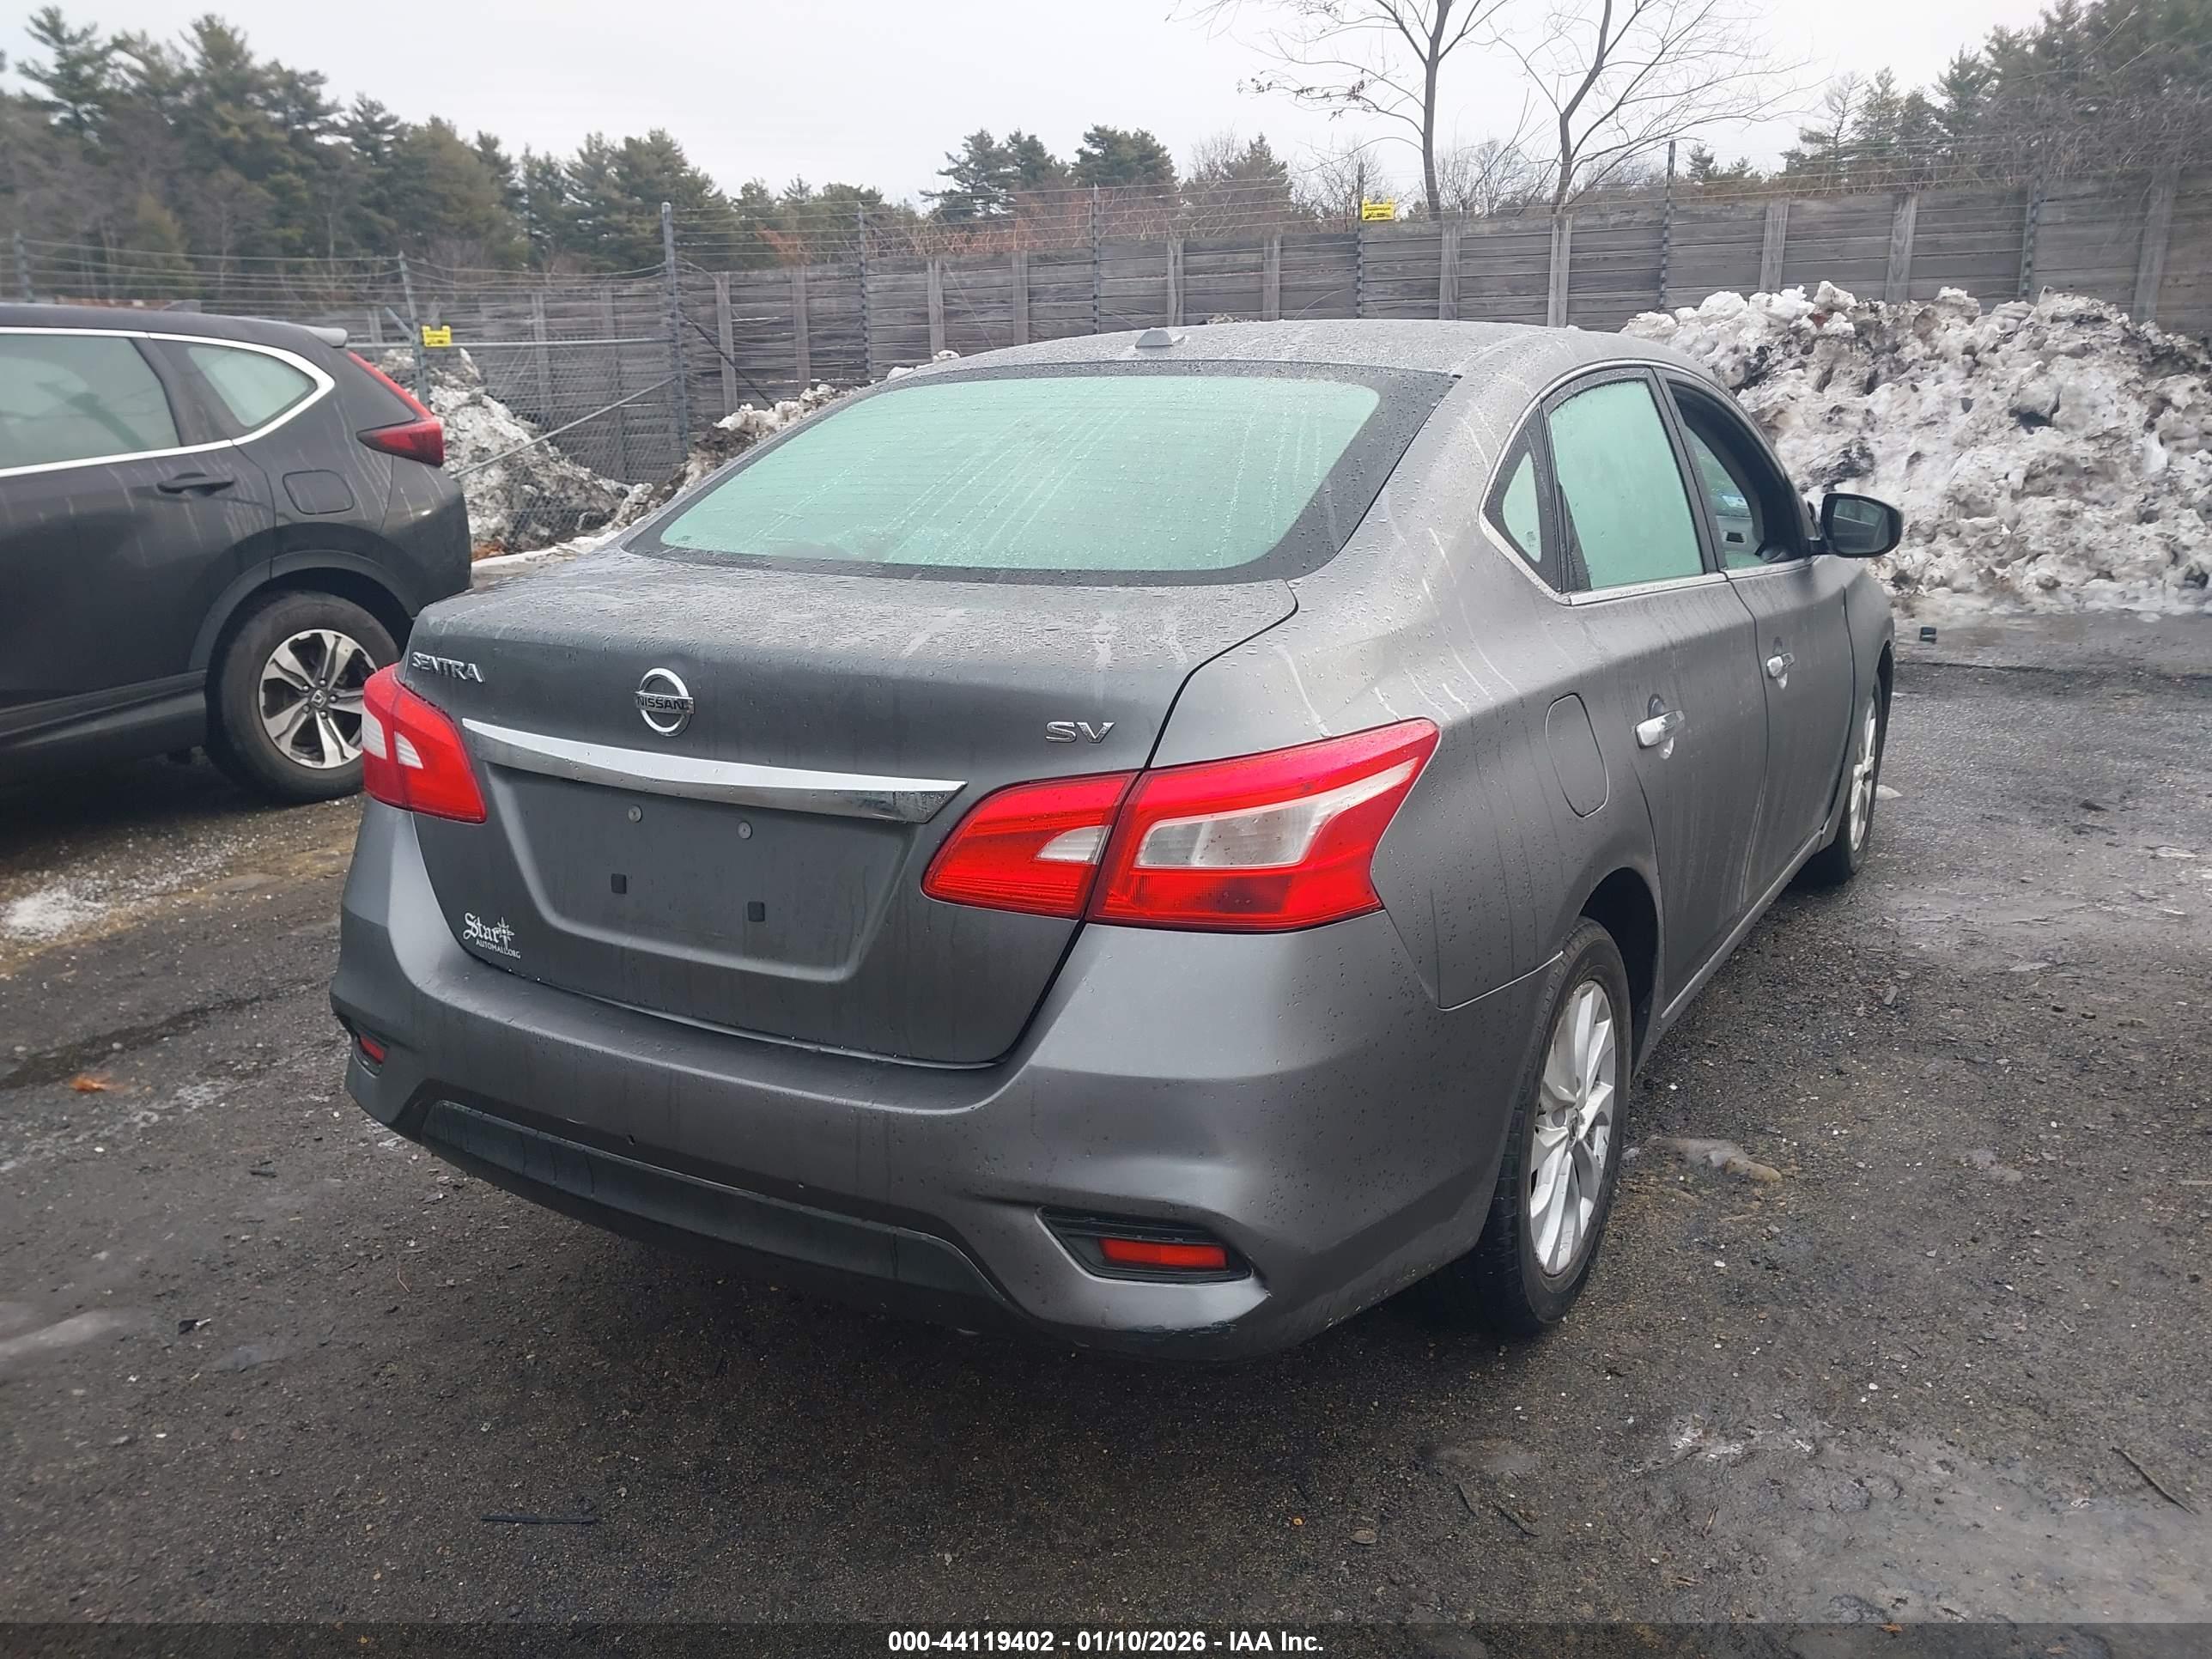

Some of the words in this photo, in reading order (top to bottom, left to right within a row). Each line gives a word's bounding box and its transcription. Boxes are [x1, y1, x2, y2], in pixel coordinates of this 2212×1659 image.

[412, 651, 485, 683] SENTRA
[636, 696, 686, 711] NISSAN
[1045, 720, 1115, 744] SV
